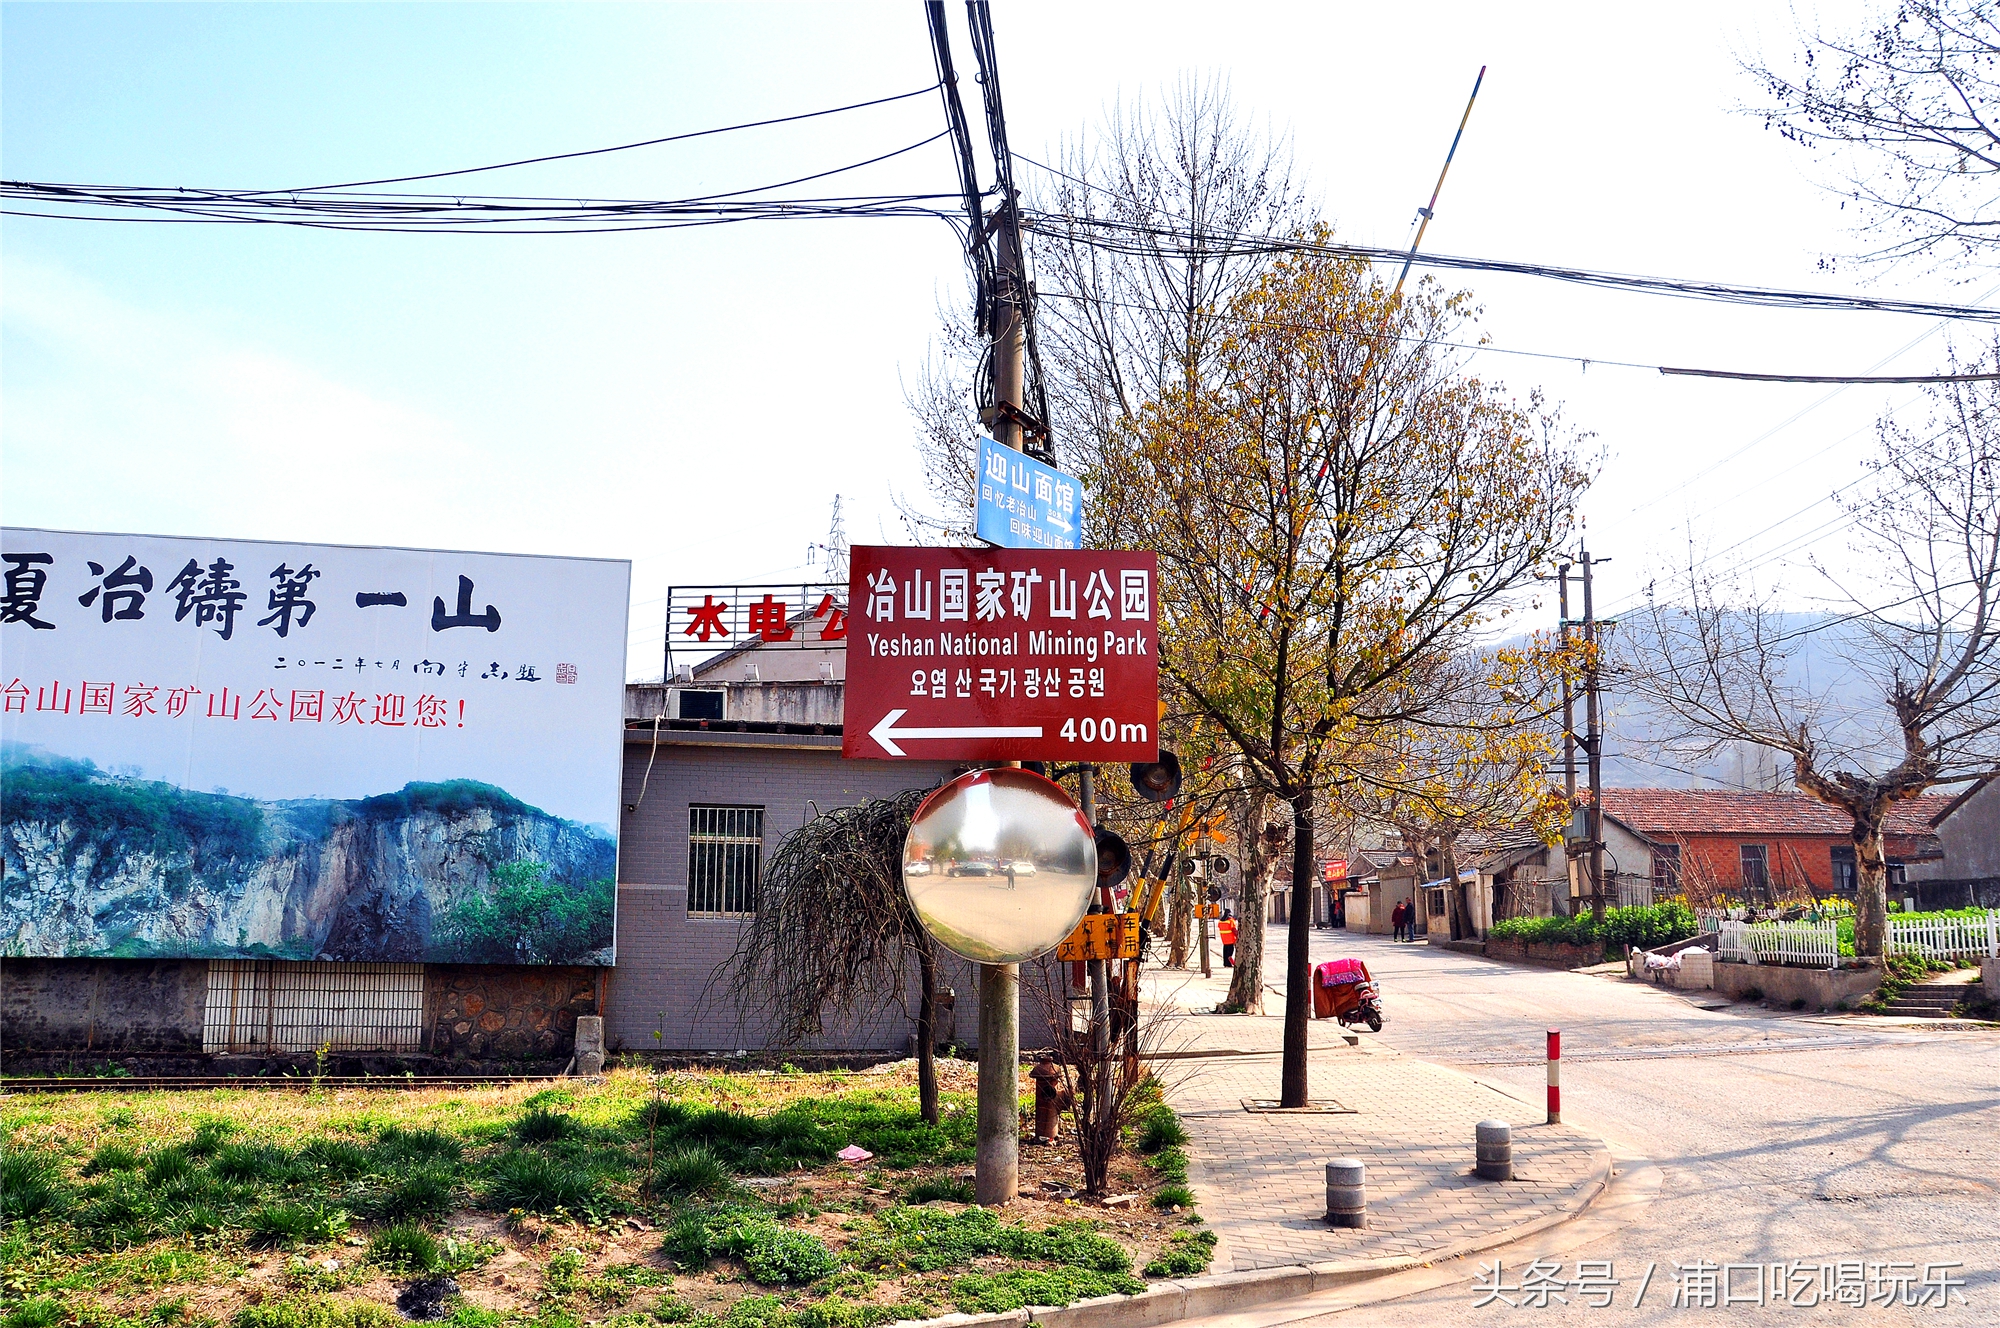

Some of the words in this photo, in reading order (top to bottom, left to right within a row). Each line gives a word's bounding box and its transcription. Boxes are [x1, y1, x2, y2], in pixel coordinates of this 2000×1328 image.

[985, 447, 1075, 515] 迎山面馆
[982, 484, 1037, 521] 回忆老冶山
[866, 567, 1149, 622] 冶山国家矿山公园
[867, 632, 935, 657] Yeshan
[940, 631, 1018, 656] National
[1028, 630, 1098, 662] Mining
[1103, 629, 1147, 655] Park
[910, 668, 947, 699] 요염
[955, 668, 972, 698] 산
[979, 667, 1017, 699] 국가
[1023, 668, 1061, 699] 광산
[1067, 667, 1106, 699] 공원
[1059, 717, 1148, 743] 400m
